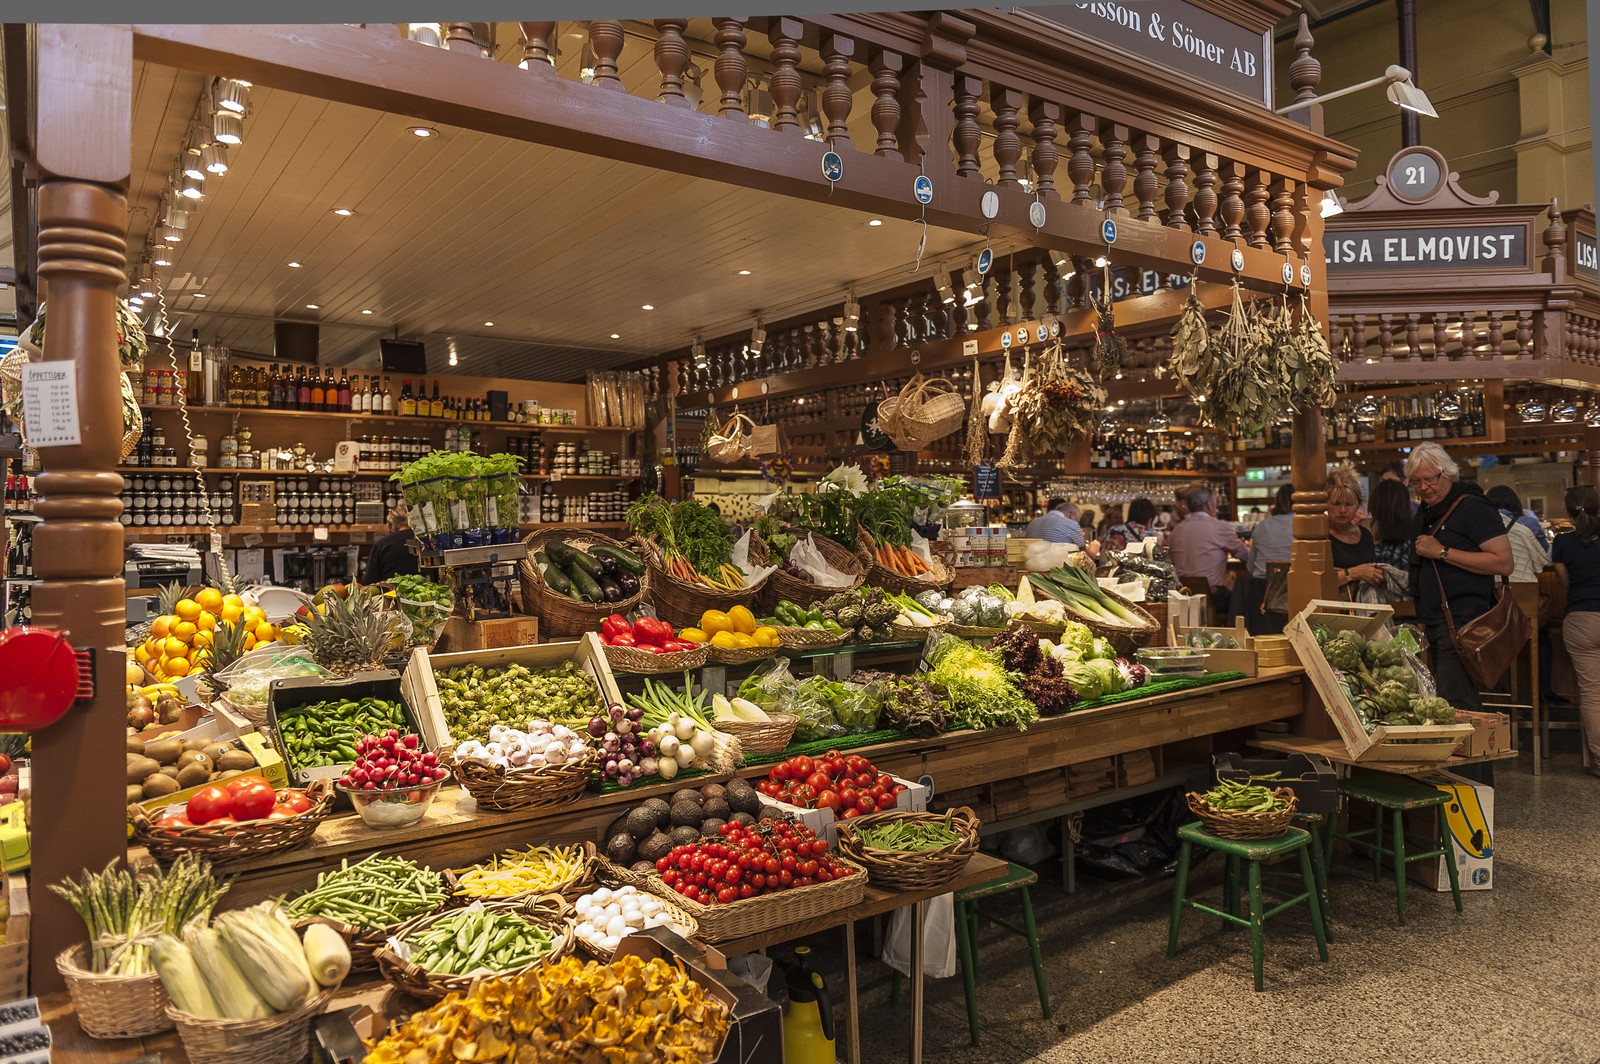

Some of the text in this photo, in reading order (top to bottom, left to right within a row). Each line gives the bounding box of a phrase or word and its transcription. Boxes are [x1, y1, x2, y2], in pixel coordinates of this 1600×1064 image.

[1148, 12, 1165, 42] &
[1172, 21, 1224, 65] Söner
[1229, 48, 1256, 77] AB
[1405, 166, 1426, 185] 21
[1325, 234, 1515, 263] ISA ELMQVIST
[1577, 241, 1598, 270] LISA
